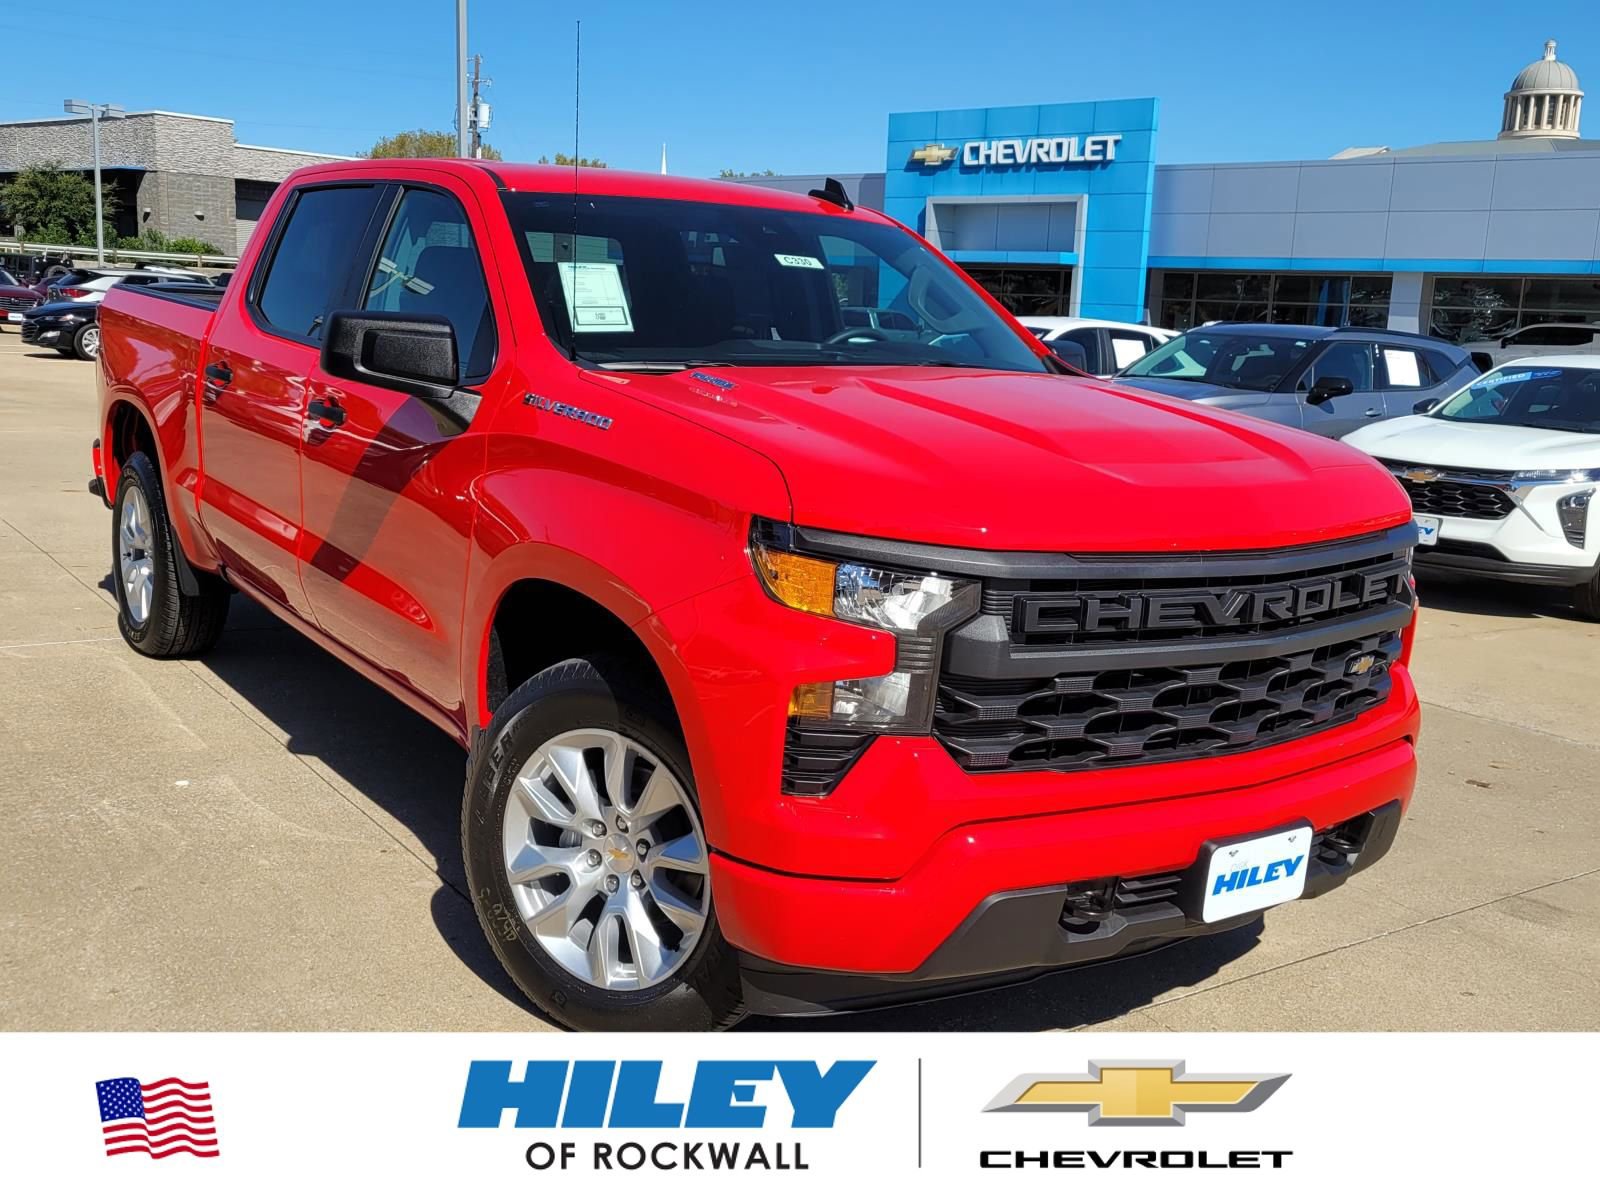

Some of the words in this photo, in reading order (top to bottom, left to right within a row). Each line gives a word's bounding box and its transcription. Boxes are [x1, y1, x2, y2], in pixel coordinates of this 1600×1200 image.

[963, 135, 1122, 165] CHEVROLET
[783, 256, 812, 266] C330
[524, 392, 613, 430] SILVERADO
[1212, 854, 1305, 896] HILEY
